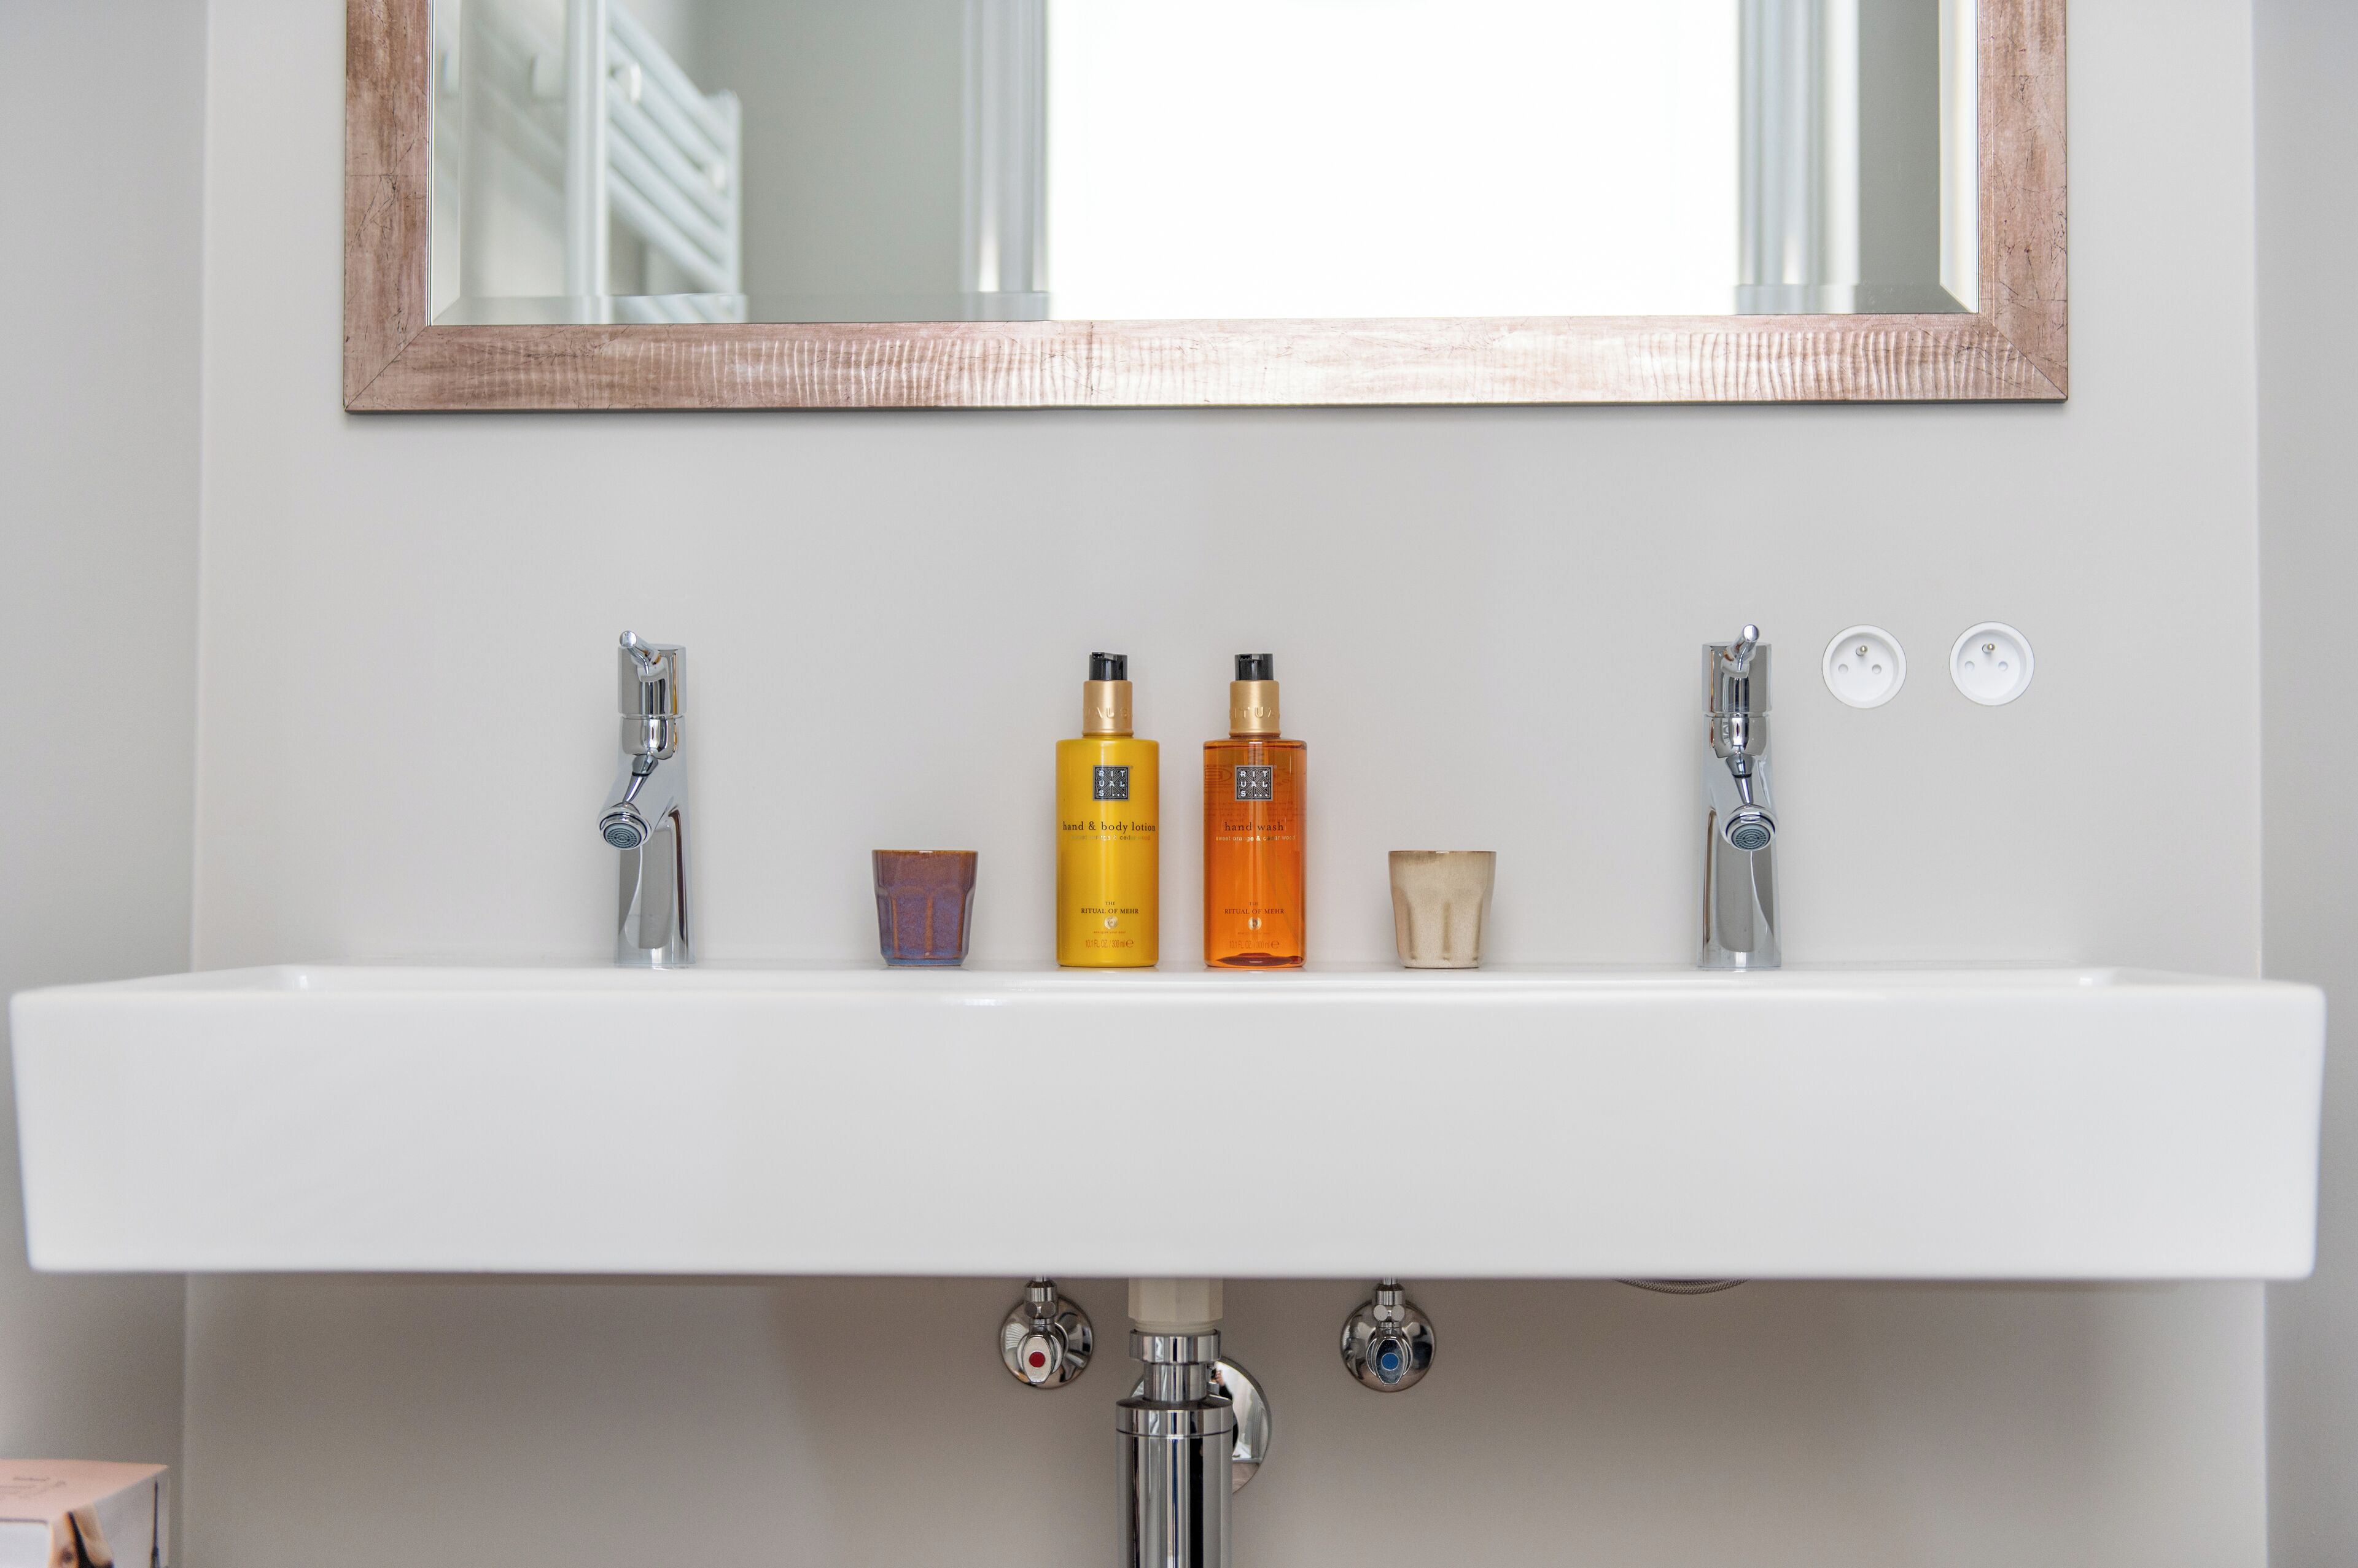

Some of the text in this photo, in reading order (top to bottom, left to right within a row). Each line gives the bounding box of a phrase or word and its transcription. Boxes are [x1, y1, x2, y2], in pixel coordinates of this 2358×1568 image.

[1063, 821, 1156, 834] hand & body lotion
[1224, 821, 1283, 831] hand wash
